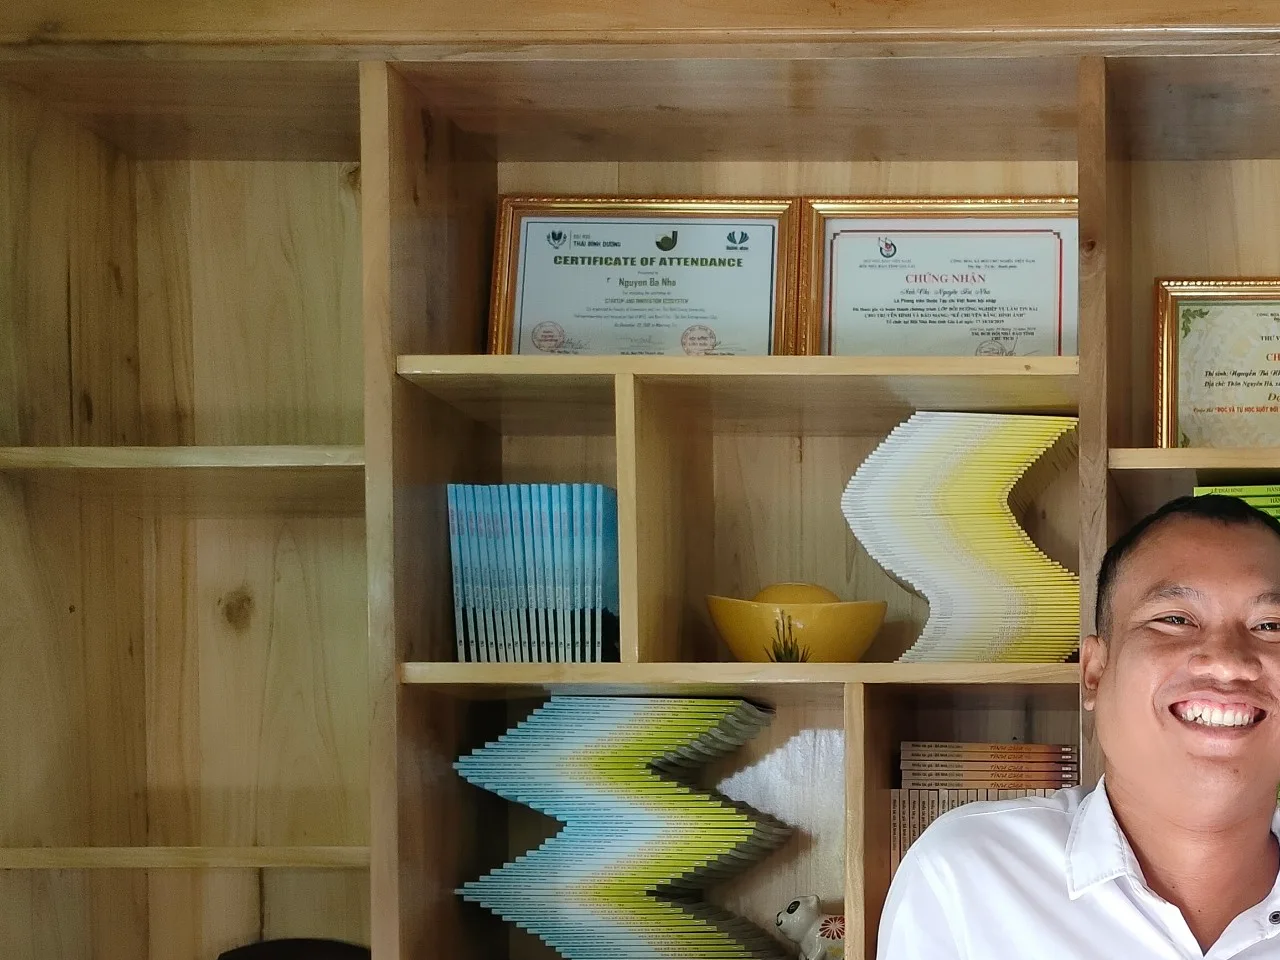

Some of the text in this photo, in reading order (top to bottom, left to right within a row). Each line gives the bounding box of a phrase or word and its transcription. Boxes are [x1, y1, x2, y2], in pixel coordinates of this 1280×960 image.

[553, 255, 743, 267] CERTIFICATE OF ATTENDANCE
[905, 272, 986, 284] CHỨNG NHẬN
